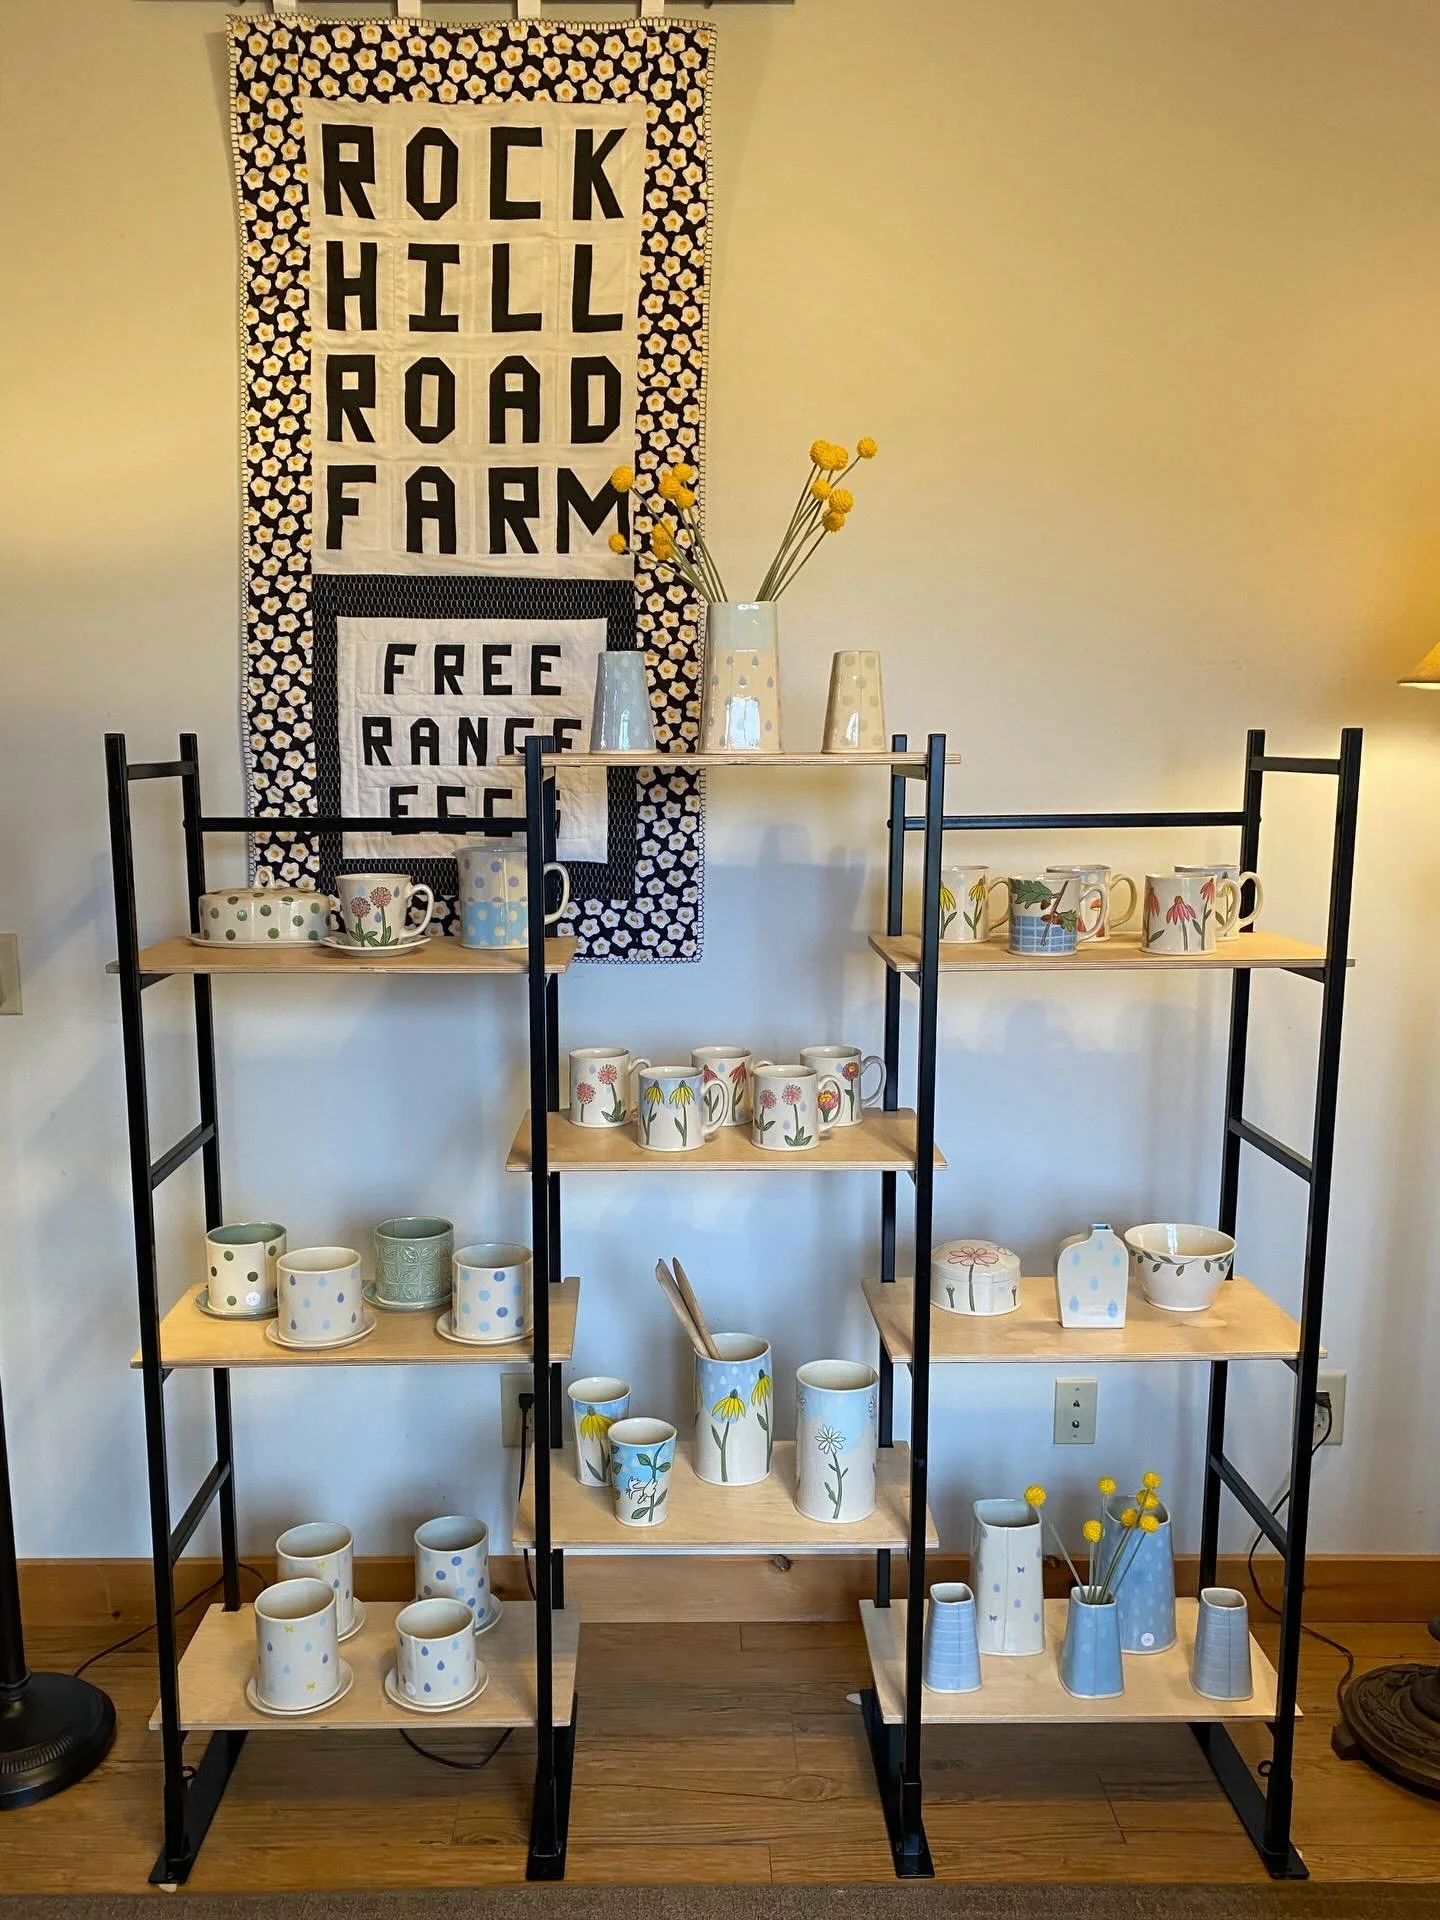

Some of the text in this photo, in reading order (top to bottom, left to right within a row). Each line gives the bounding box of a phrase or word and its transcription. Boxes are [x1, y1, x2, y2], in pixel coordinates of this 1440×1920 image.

[321, 123, 628, 221] ROCK
[326, 240, 624, 333] HILL
[325, 354, 622, 444] ROAD
[326, 464, 631, 555] FARM
[383, 643, 562, 696] FREE
[389, 785, 561, 838] EGG
